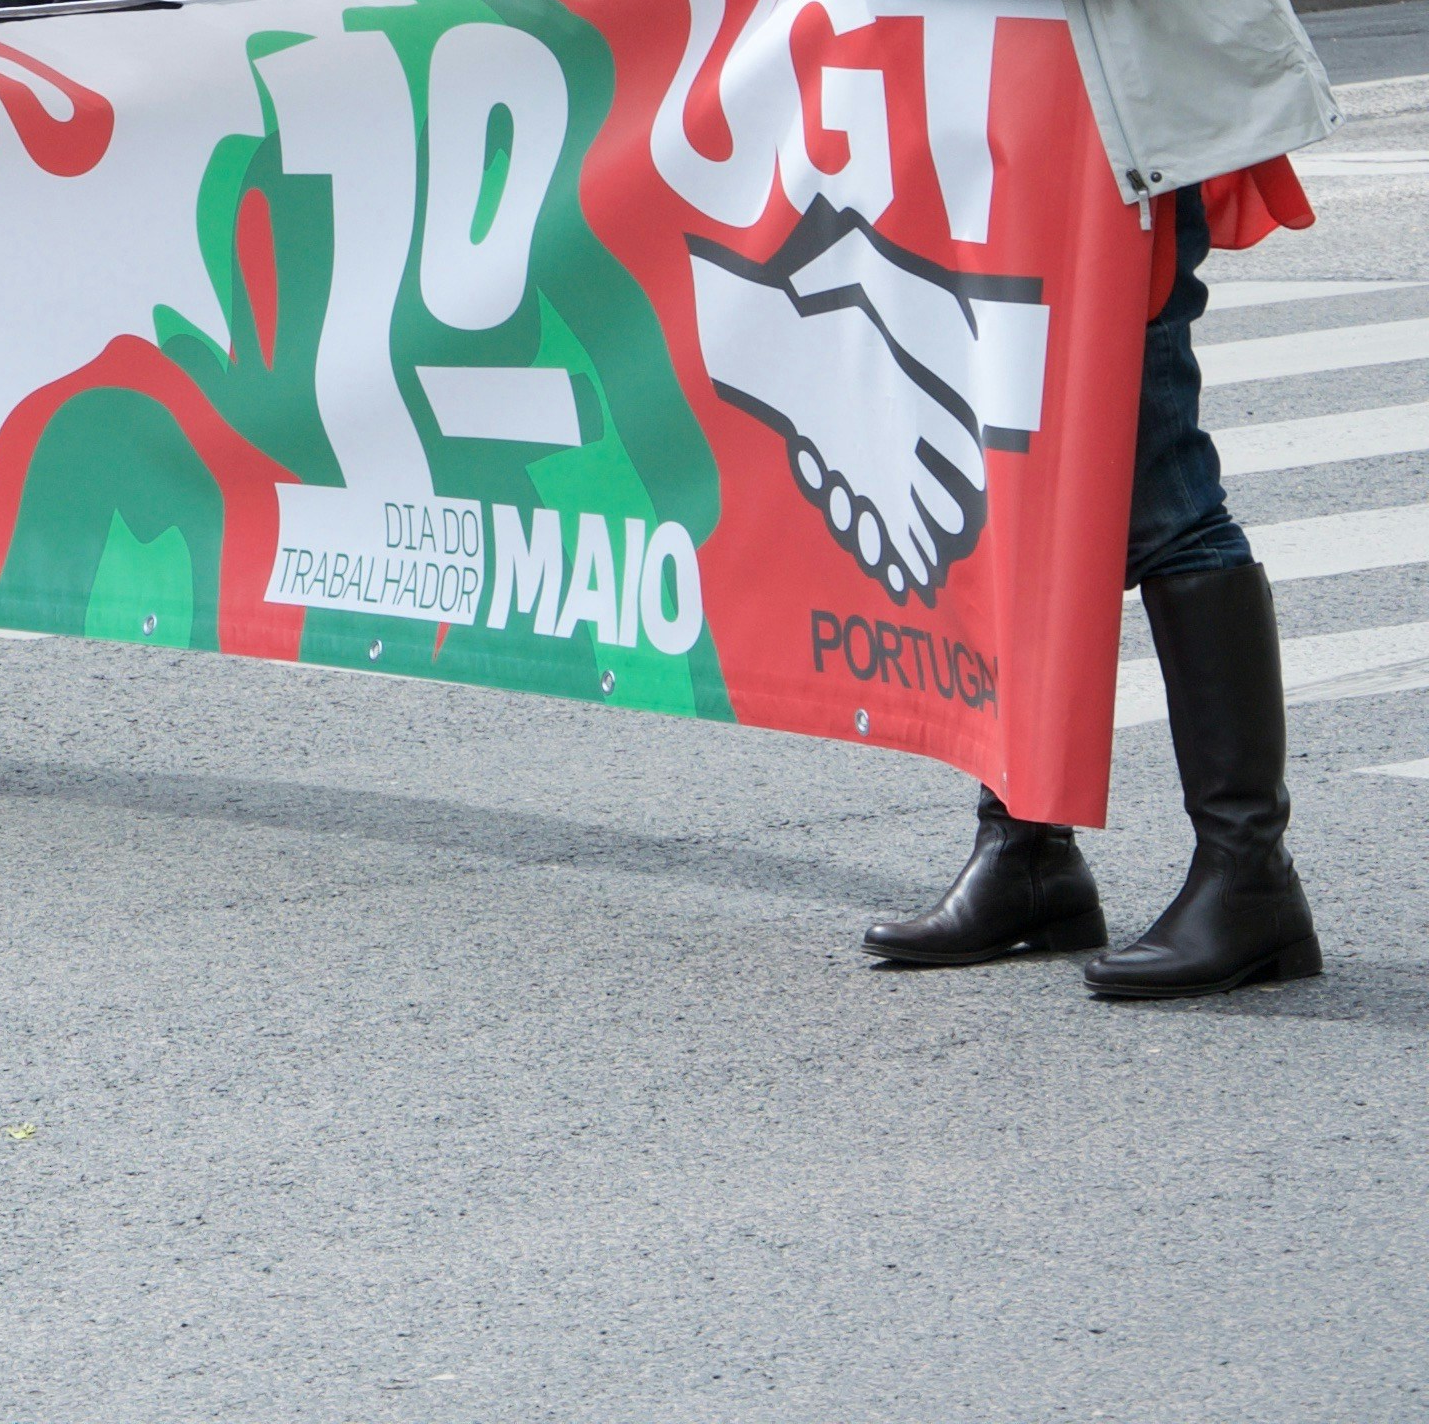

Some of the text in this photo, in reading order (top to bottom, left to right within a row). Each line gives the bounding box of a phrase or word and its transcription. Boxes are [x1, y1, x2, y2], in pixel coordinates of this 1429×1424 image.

[384, 502, 480, 557] DIA DO
[278, 547, 479, 615] TRABALHADOR
[486, 502, 704, 655] MAIO
[811, 609, 999, 720] PORTUGA
